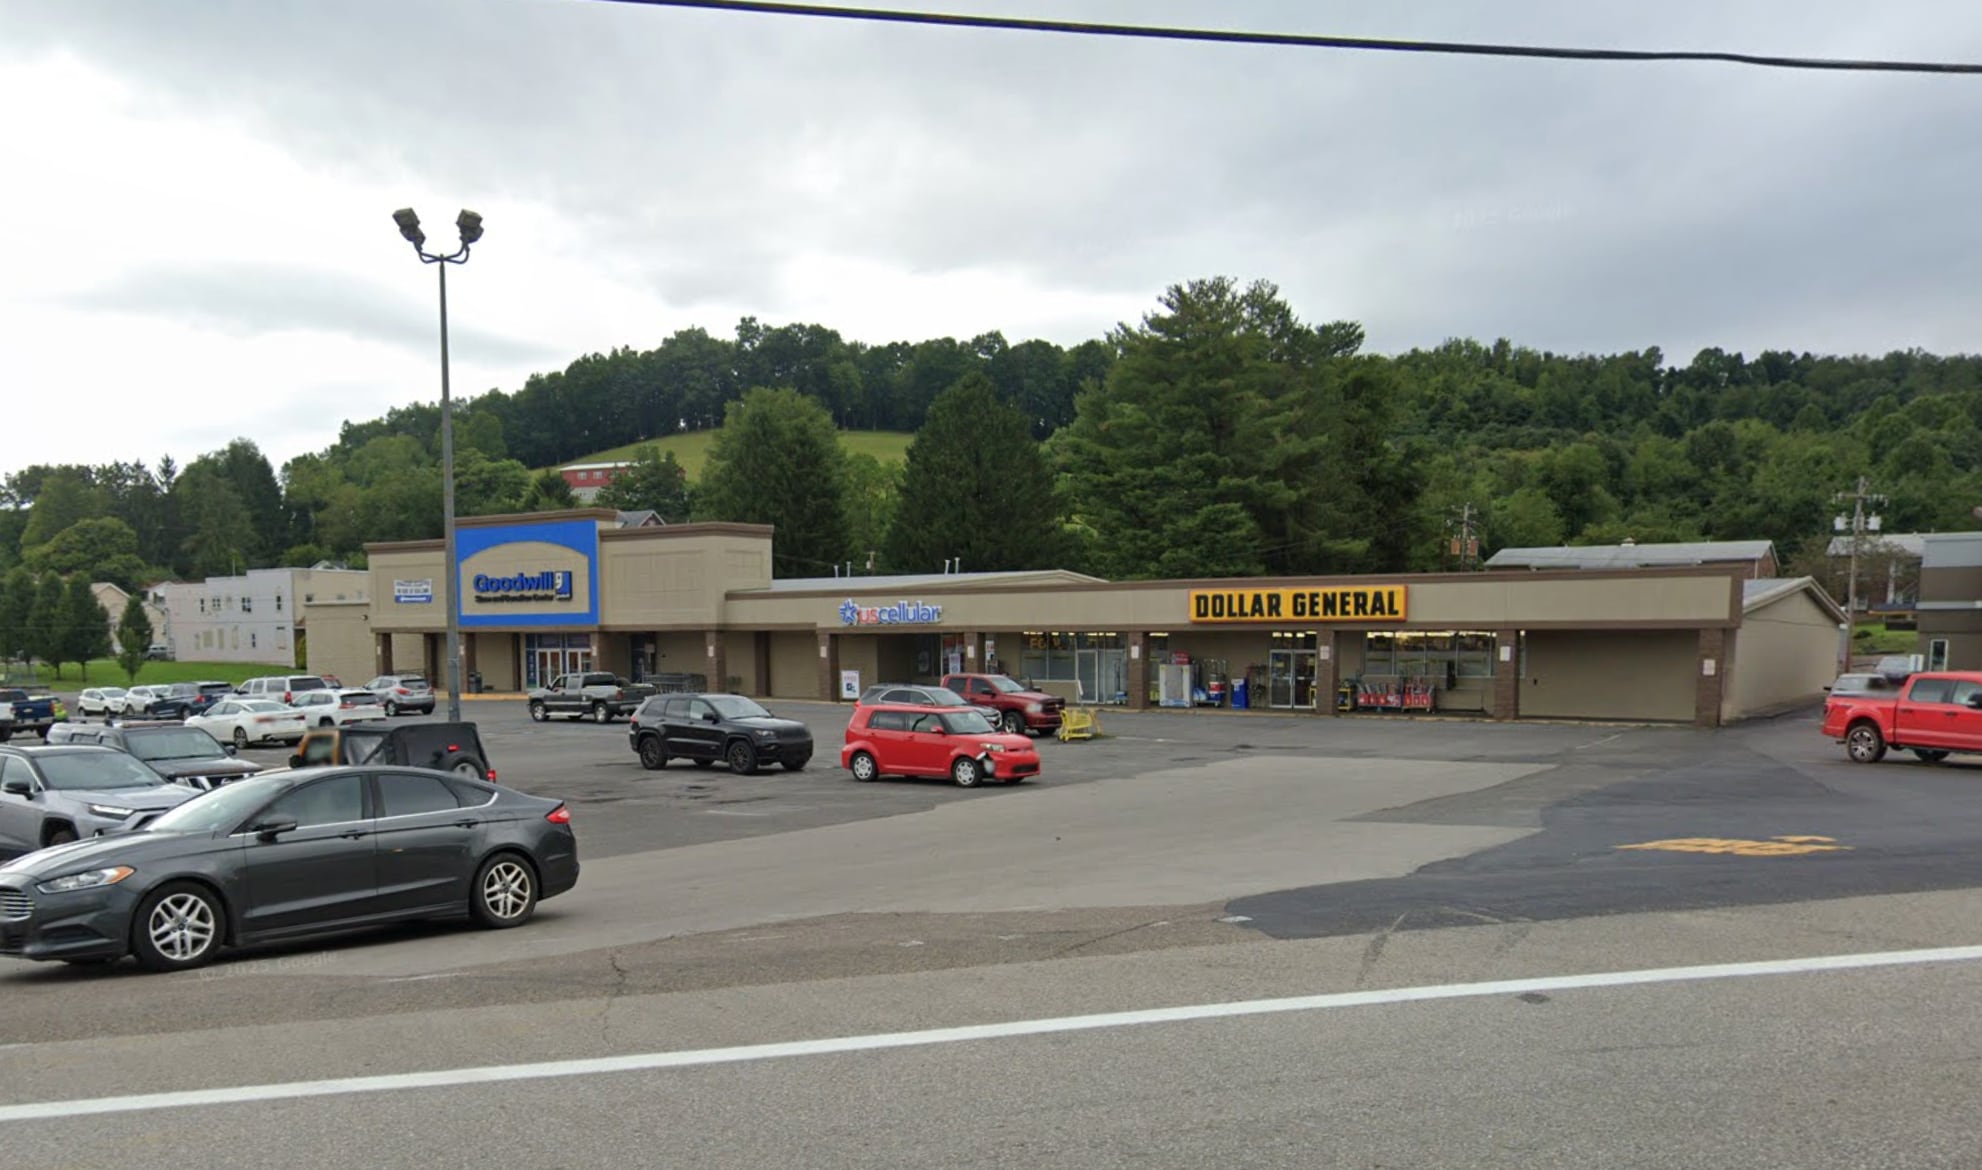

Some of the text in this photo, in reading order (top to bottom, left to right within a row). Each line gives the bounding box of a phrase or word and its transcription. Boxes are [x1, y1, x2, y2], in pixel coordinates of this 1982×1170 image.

[473, 571, 554, 592] Goodwill
[1194, 590, 1400, 618] DOLLAR GENERAL
